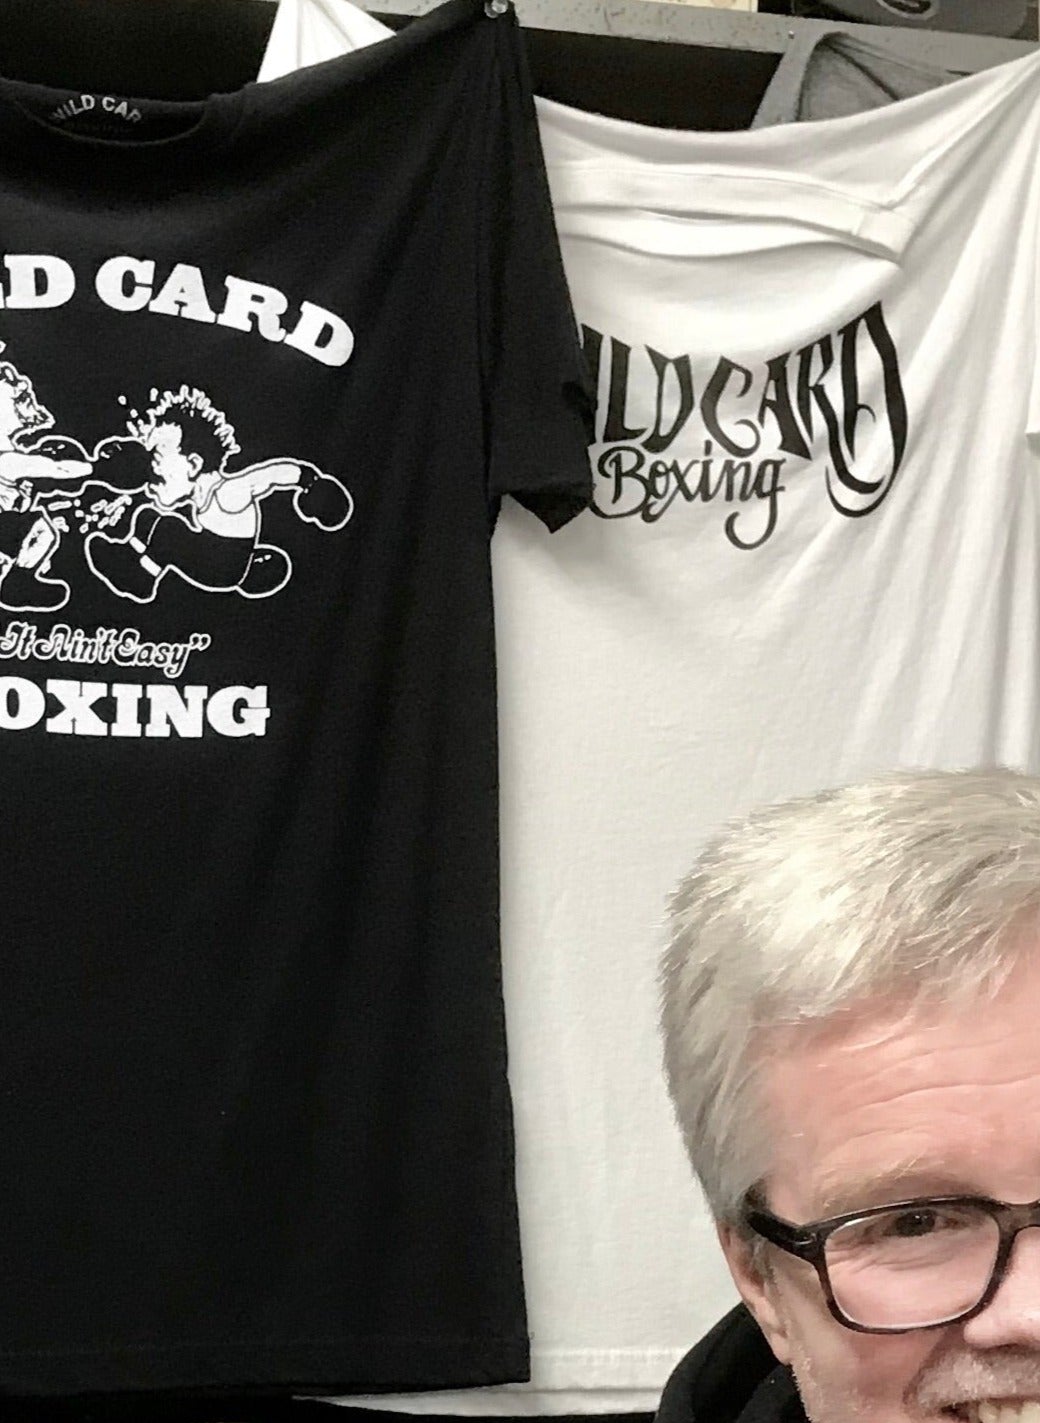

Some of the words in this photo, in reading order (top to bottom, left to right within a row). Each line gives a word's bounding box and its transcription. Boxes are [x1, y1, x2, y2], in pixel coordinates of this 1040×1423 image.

[95, 256, 354, 366] CARD
[700, 301, 909, 517] CARD
[588, 439, 786, 550] Boxing
[0, 676, 271, 738] OXING
